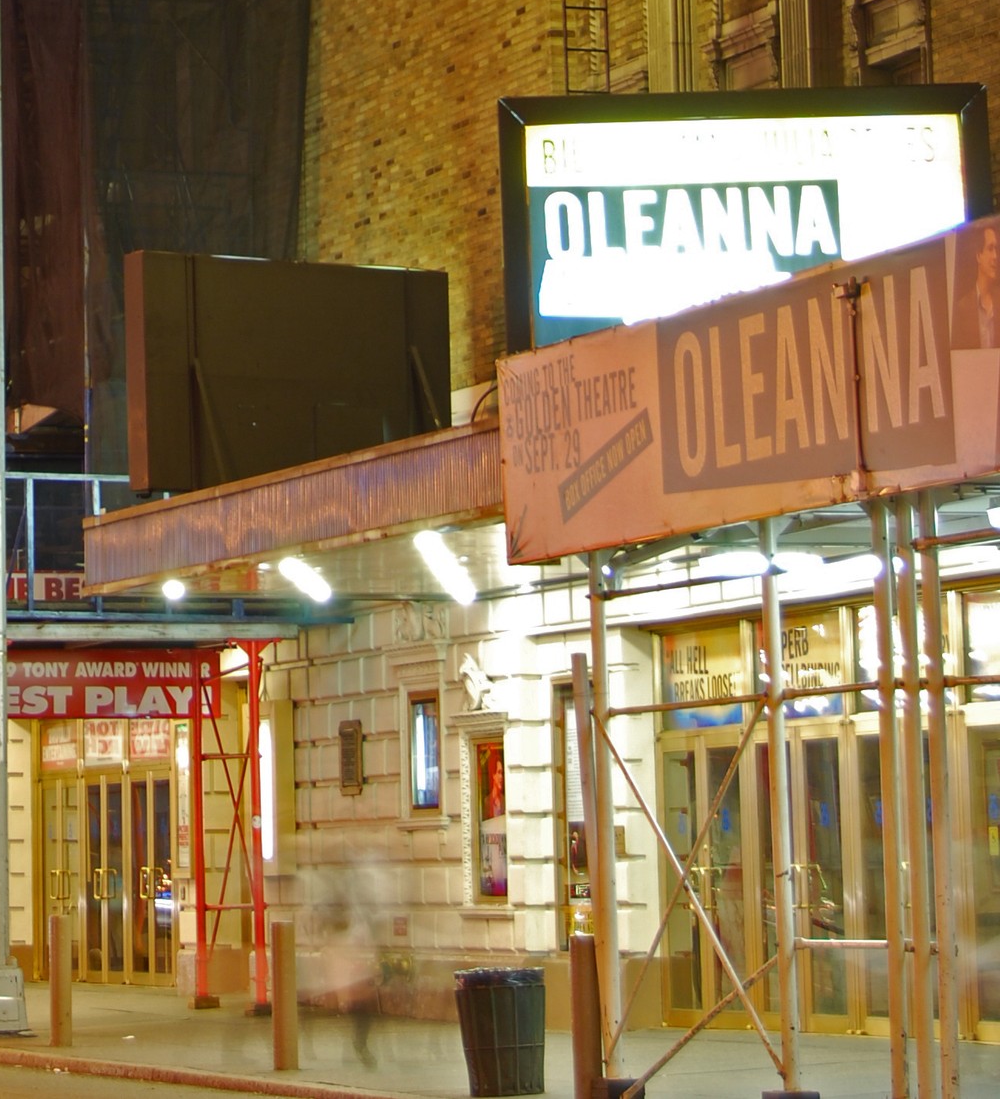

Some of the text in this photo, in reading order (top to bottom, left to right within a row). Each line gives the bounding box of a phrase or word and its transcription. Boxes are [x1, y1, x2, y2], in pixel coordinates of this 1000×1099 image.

[543, 184, 838, 259] OLEANNA
[503, 355, 576, 406] COMING TO THE
[674, 266, 946, 478] OLEANNA
[515, 366, 637, 440] GOLDEN THEATRE
[525, 432, 559, 474] SEPT.
[564, 429, 581, 469] 29
[564, 419, 648, 511] BOX OFFICE NOW OPEN
[44, 577, 85, 601] BE
[22, 662, 69, 677] TONY
[75, 661, 137, 678] AWARD
[142, 662, 211, 678] WINNR
[686, 646, 709, 674] HELL
[85, 686, 213, 714] PLAY!
[674, 677, 705, 702] BREAKS
